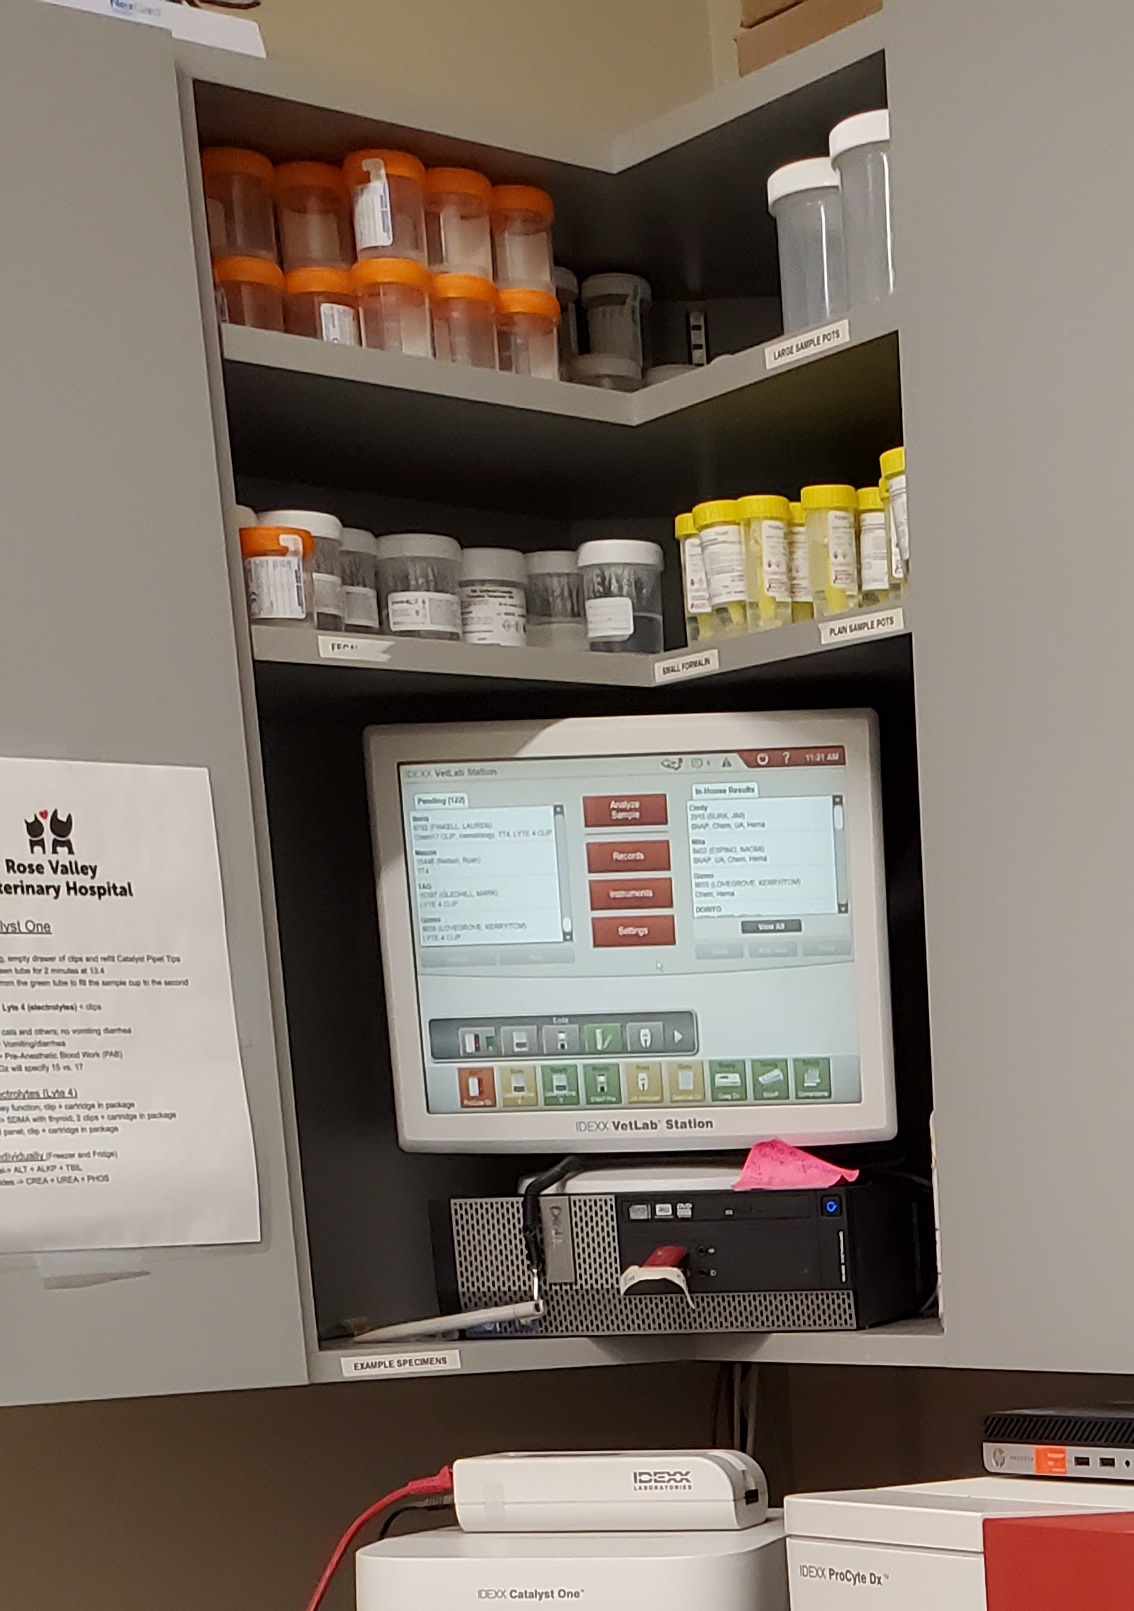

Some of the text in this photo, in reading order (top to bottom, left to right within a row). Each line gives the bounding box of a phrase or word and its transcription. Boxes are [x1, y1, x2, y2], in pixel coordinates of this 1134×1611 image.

[773, 329, 840, 360] LARGE SAMPLE POTS
[829, 616, 894, 637] PLAIN SAMPLE POTS
[662, 657, 711, 676] SMALL FORMALIN
[434, 769, 464, 778] VetLab
[467, 768, 497, 776] Station
[728, 786, 755, 794] Results
[610, 800, 640, 810] Analyze
[611, 810, 640, 820] Sample
[612, 852, 644, 861] Records
[5, 859, 98, 880] Rose Valley
[65, 881, 133, 901] Hospital
[610, 889, 654, 898] Instruments
[25, 919, 51, 934] One
[618, 926, 648, 936] Settings
[59, 954, 66, 962] of
[117, 955, 145, 964] Catalyst
[166, 955, 181, 964] Tips
[21, 1003, 26, 1011] 4
[576, 1120, 609, 1132] IDEXX
[666, 1118, 714, 1130] Station
[354, 1357, 448, 1371] EXAMPLE SPECIMENS
[633, 1471, 691, 1484] IDEXX
[799, 1564, 826, 1579] IDEXX
[828, 1568, 867, 1586] ProCyte
[478, 1589, 506, 1599] IDEXX
[509, 1588, 554, 1601] Catalyst
